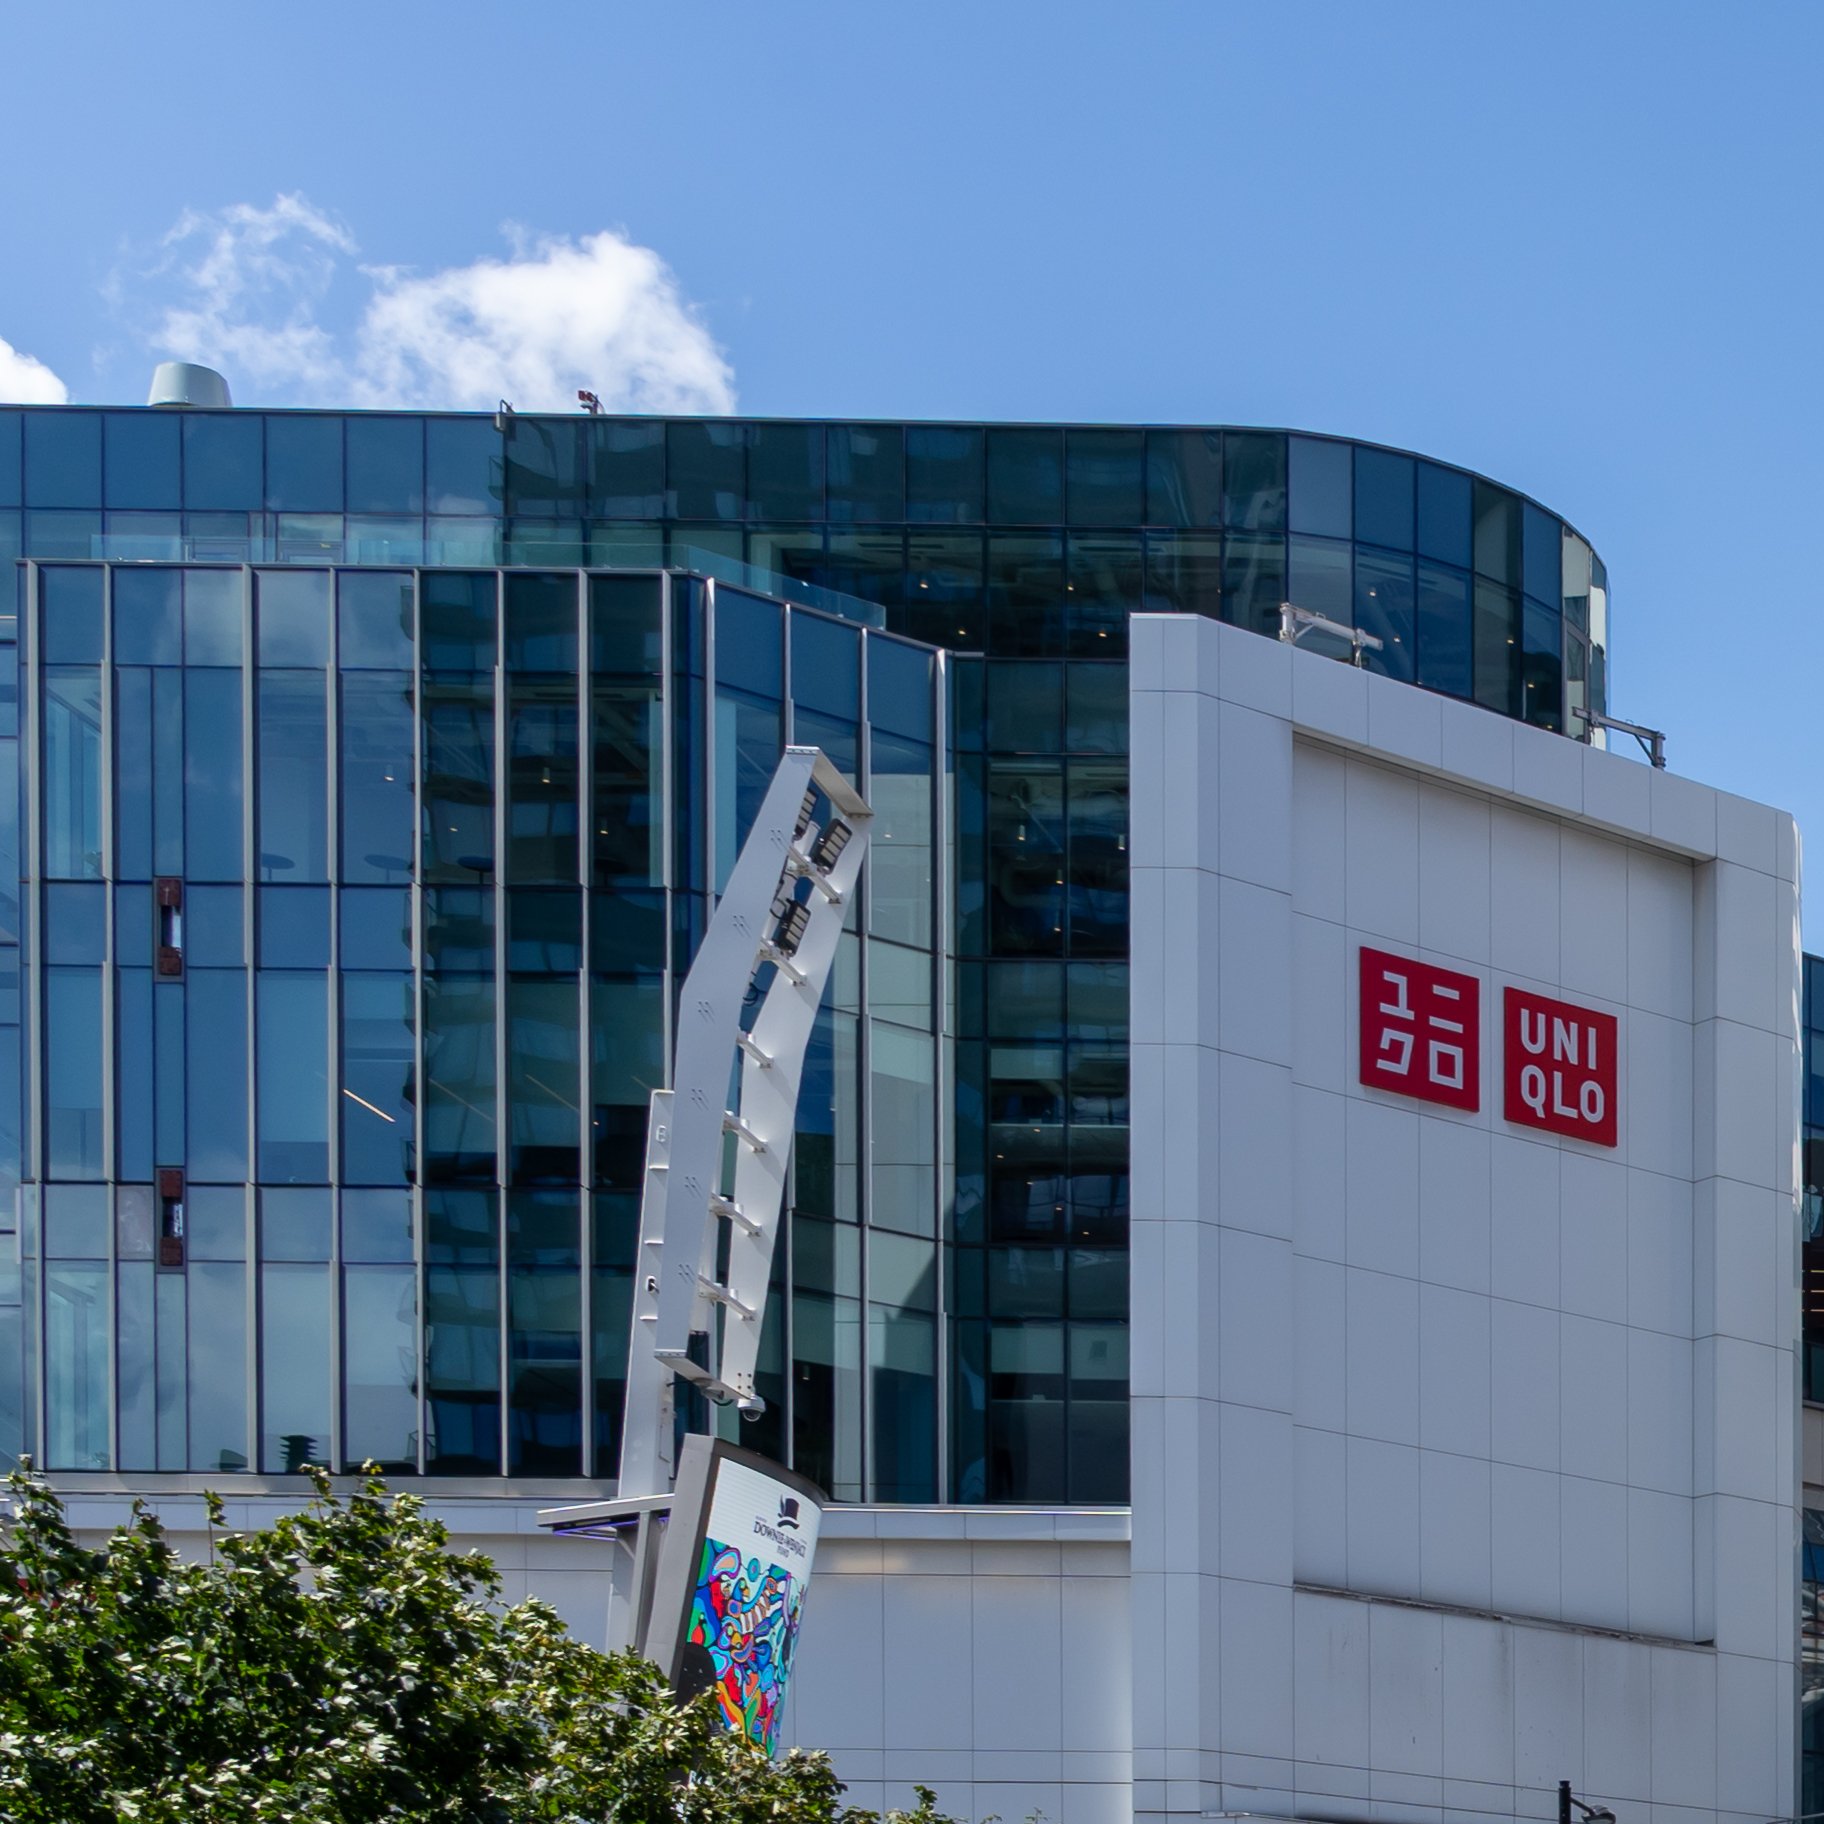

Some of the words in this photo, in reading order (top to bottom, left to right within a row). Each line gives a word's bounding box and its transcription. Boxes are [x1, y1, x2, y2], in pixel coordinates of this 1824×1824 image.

[1379, 970, 1464, 1034] ユニ
[1520, 1008, 1597, 1071] UNI
[1520, 1064, 1605, 1124] QLO
